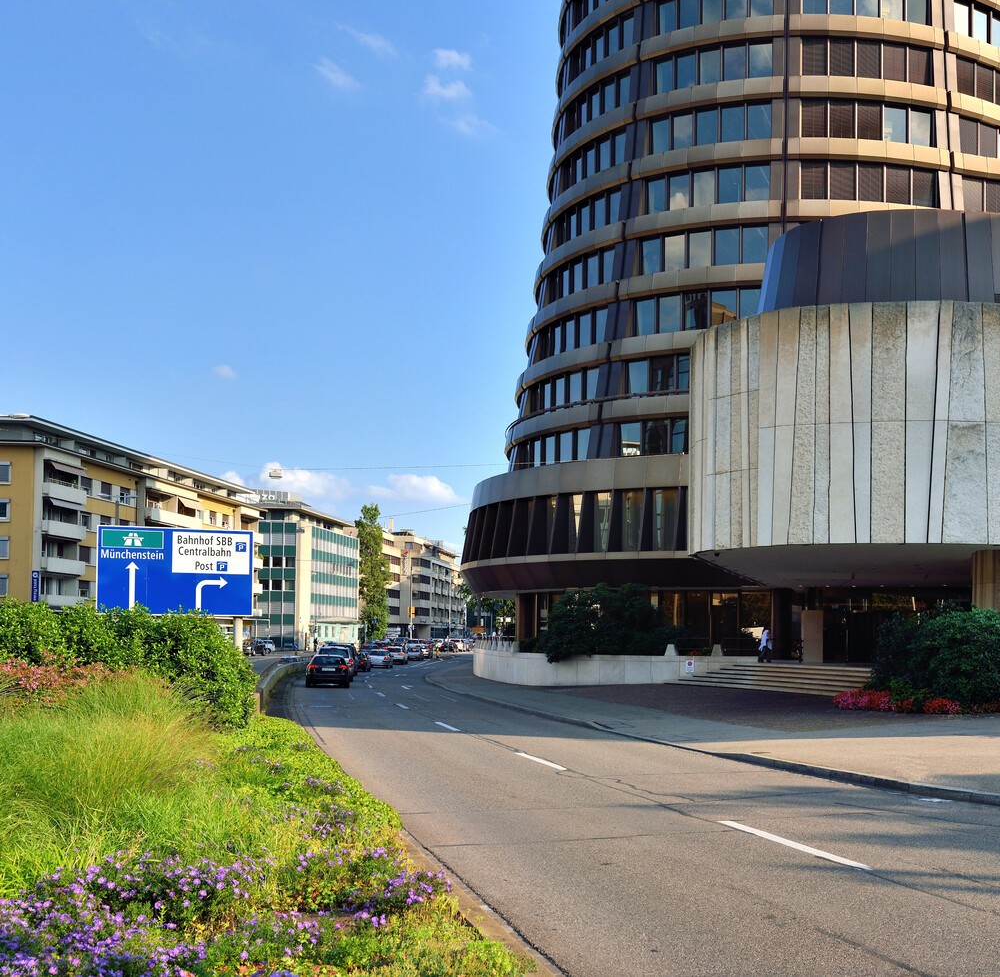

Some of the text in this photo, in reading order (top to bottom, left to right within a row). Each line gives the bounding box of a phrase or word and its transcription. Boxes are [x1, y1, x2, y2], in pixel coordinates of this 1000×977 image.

[177, 535, 233, 546] Bahnhof SBB
[100, 548, 164, 560] Münchenstein
[178, 546, 232, 557] Centralbahn
[195, 561, 213, 570] Post
